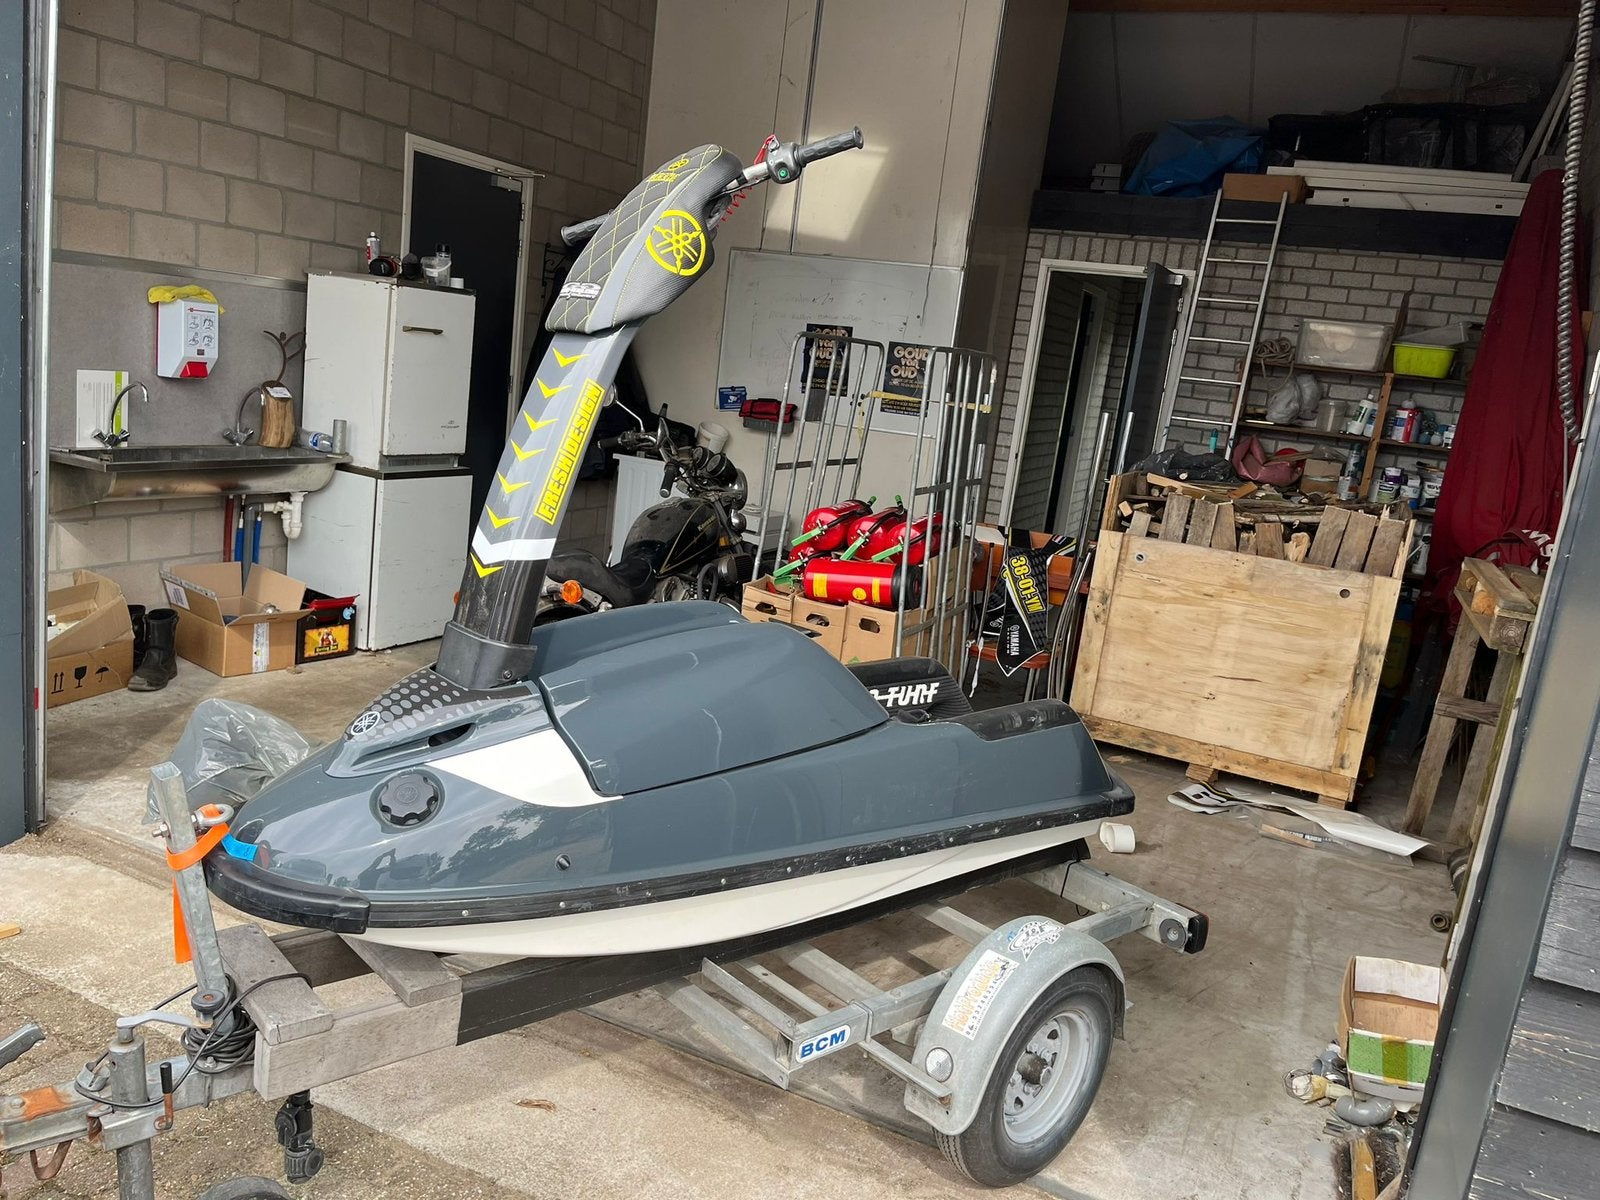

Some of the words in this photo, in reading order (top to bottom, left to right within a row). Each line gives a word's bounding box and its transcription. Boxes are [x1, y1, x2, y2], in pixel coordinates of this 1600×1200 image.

[893, 345, 929, 361] GOUD
[890, 364, 918, 379] OUD
[537, 454, 574, 522] FRESH
[563, 382, 602, 457] DESIGN
[1010, 630, 1020, 657] YAMAHA
[800, 1029, 846, 1059] BCM
